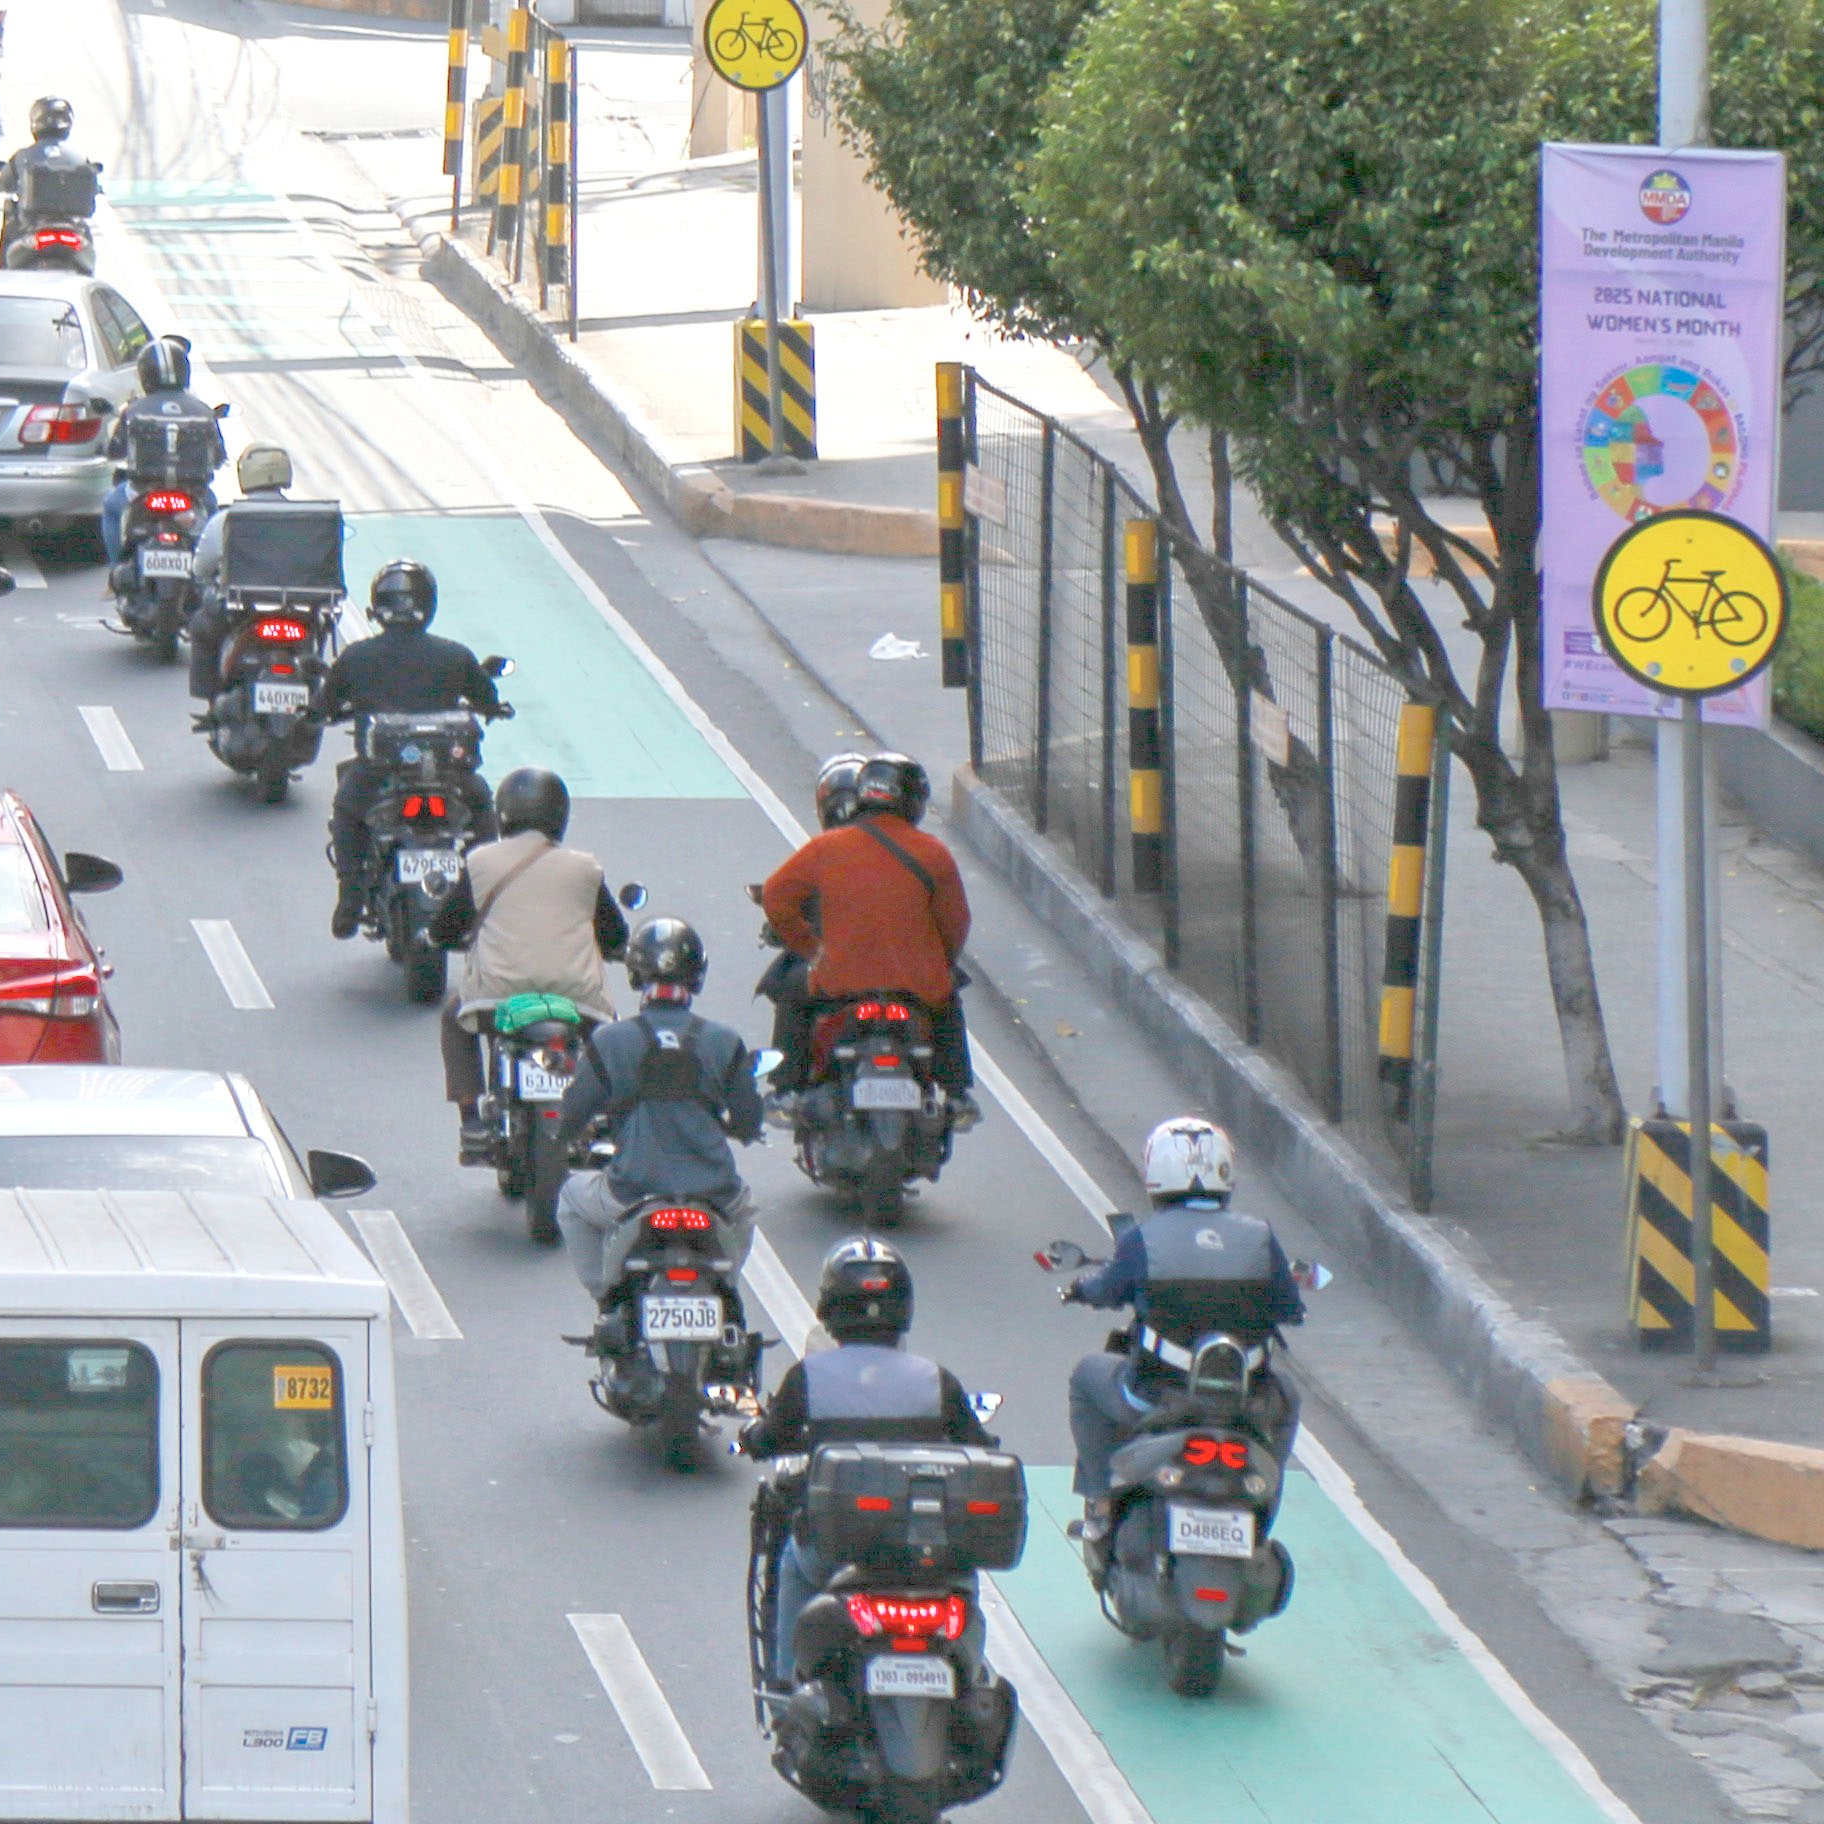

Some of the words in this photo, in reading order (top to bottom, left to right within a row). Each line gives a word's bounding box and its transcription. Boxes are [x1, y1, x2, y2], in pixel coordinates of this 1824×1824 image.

[1644, 193, 1687, 206] MMDA
[1582, 227, 1608, 241] The
[1613, 229, 1700, 248] Metropolitan
[1702, 233, 1745, 248] Manila
[1583, 243, 1674, 261] Development
[1677, 246, 1740, 266] Authority
[1637, 288, 1727, 310] NATIONAL
[1586, 314, 1672, 334] WOMEN'S
[1675, 318, 1742, 337] MONTH
[648, 1308, 717, 1329] 275QJB
[287, 1377, 330, 1400] 8732
[1180, 1523, 1244, 1543] D486EQ
[242, 1738, 284, 1748] L300
[290, 1728, 325, 1747] FB
